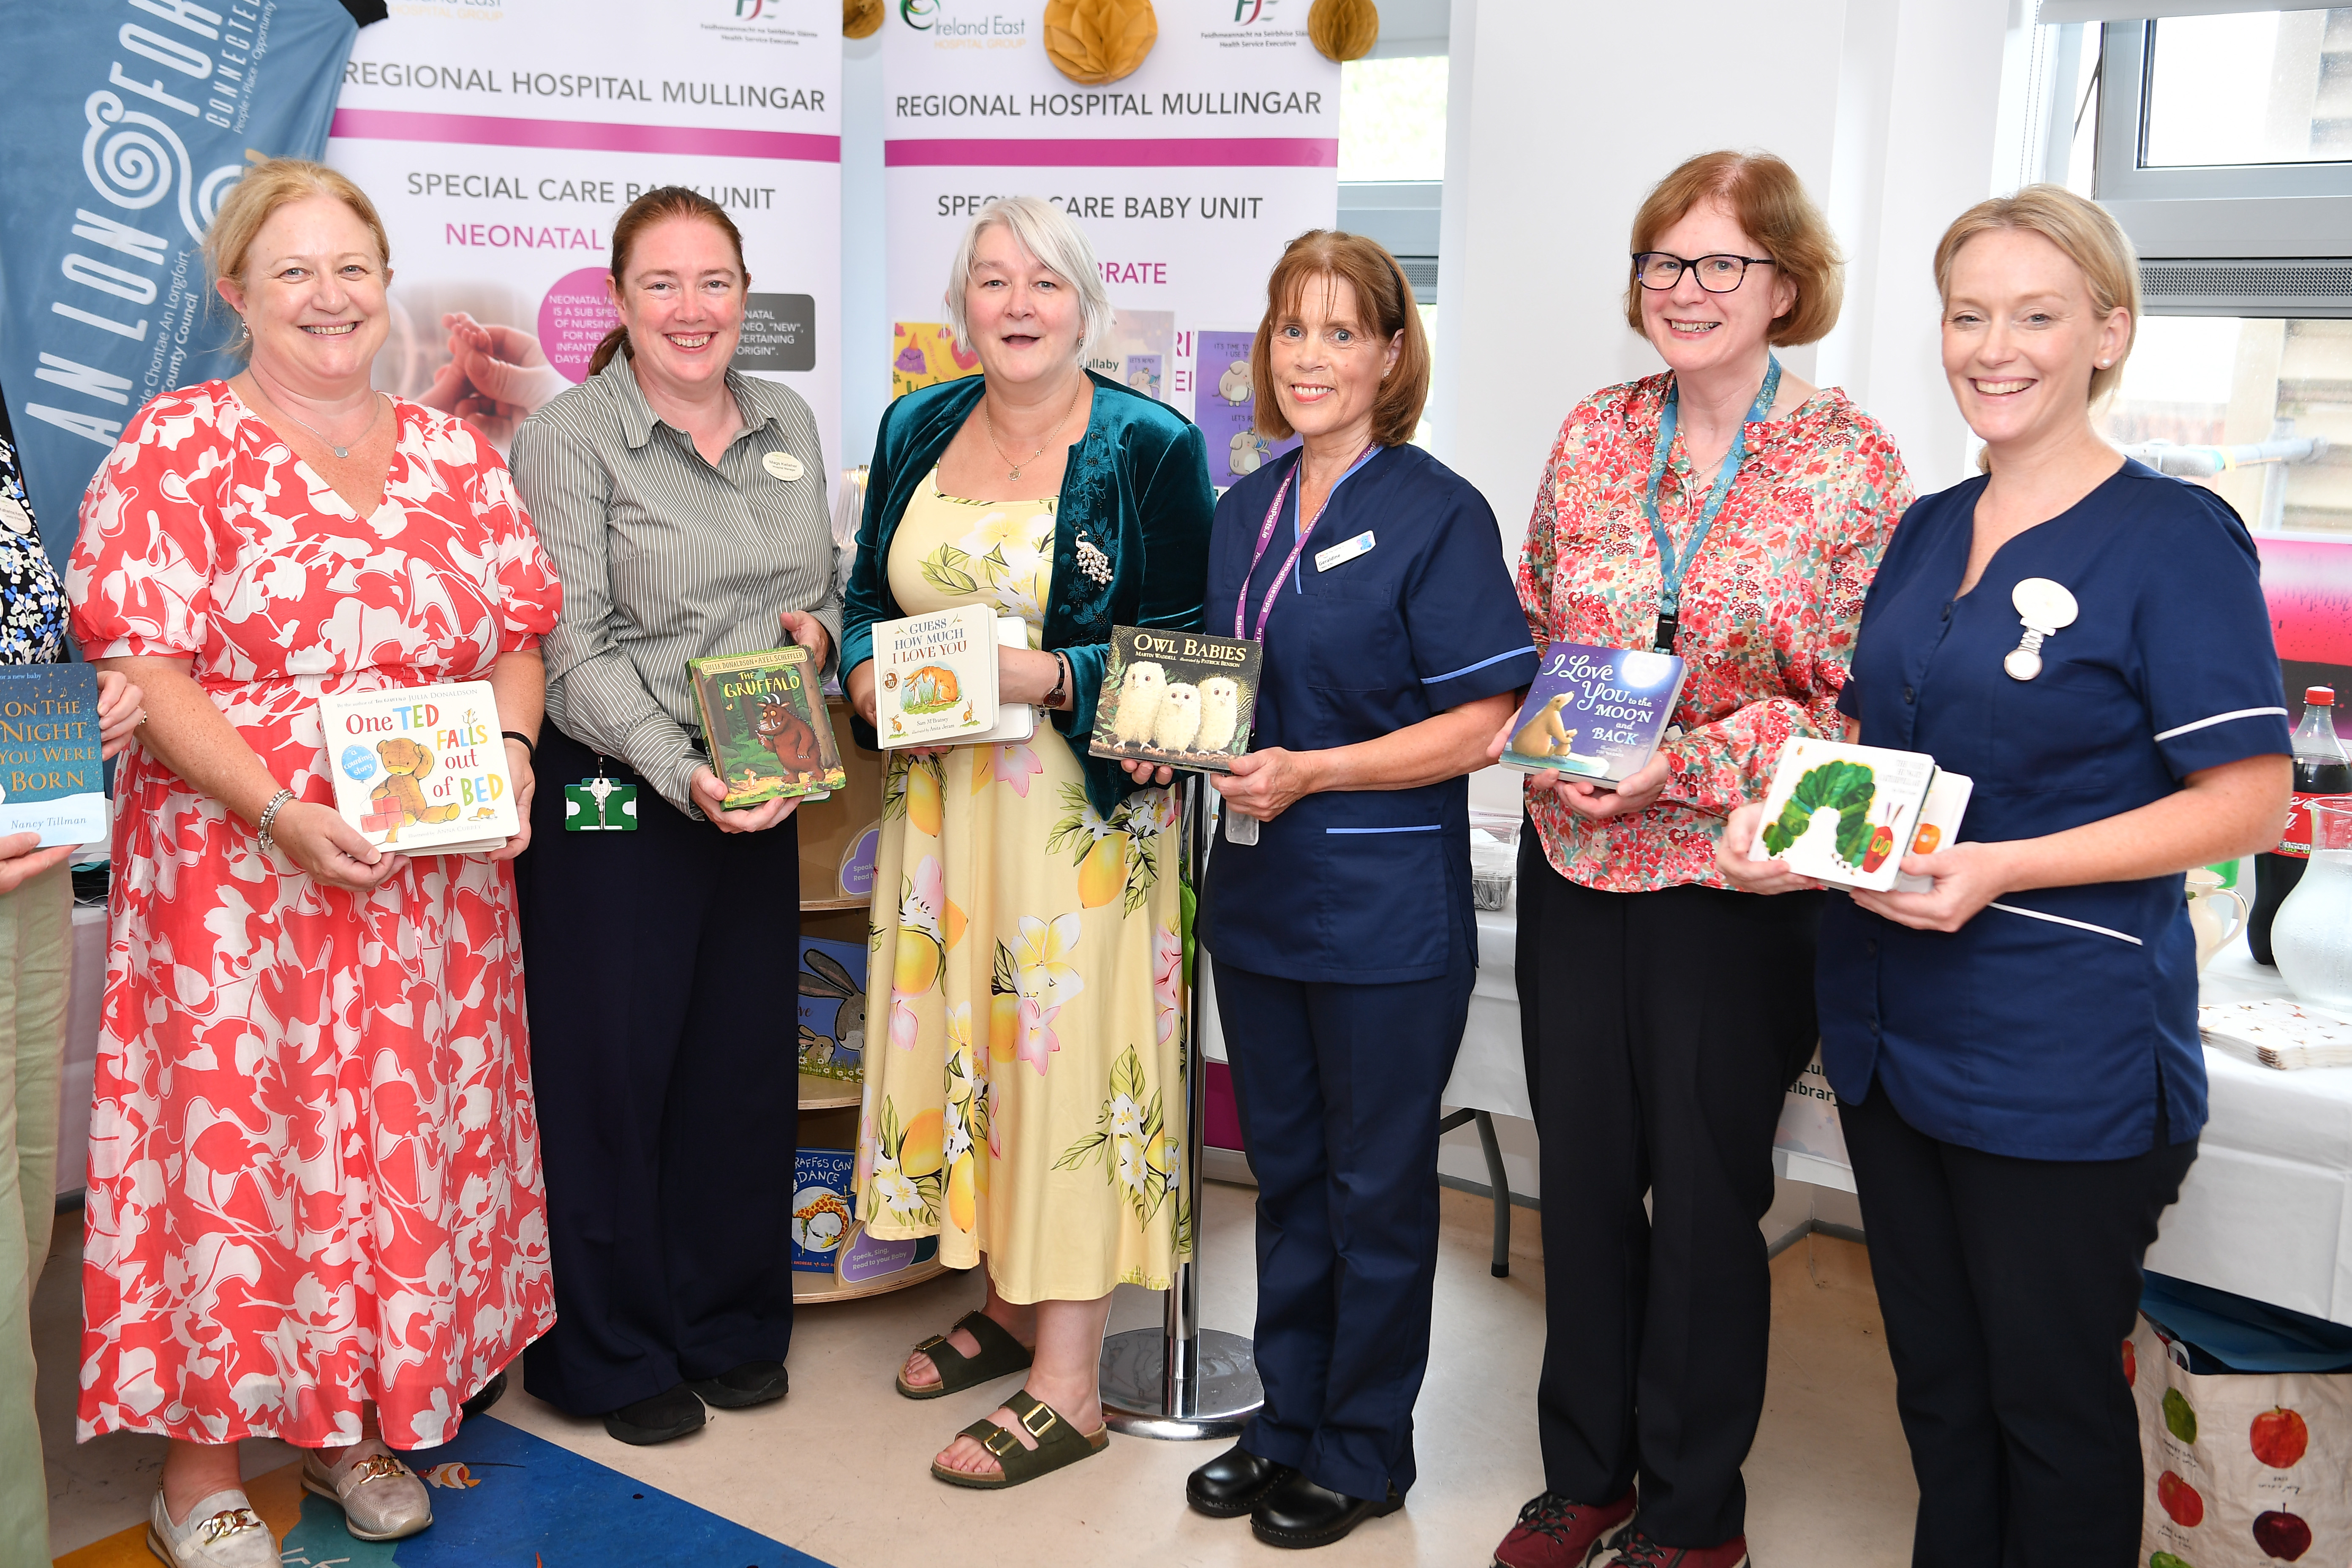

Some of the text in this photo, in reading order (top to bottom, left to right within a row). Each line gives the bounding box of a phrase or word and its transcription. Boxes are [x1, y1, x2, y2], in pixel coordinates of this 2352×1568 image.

[935, 16, 1025, 35] Ireland East
[934, 39, 1026, 49] HOSPITAL GROUP
[205, 0, 261, 129] CONNECTE
[343, 61, 825, 112] REGIONAL HOSPITAL MULLINGAR
[232, 99, 250, 134] People
[242, 66, 258, 94] Place
[896, 91, 1322, 118] REGIONAL HOSPITAL MULLINGAR
[407, 172, 528, 201] SPECIAL
[538, 179, 615, 204] CARE
[711, 186, 776, 210] UNIT
[1124, 197, 1190, 219] BABY
[1200, 197, 1263, 220] UNIT
[445, 223, 604, 251] NEONATAL
[550, 296, 602, 305] NEONATAL
[144, 250, 191, 388] Chontae An Longfoirt
[175, 293, 199, 345] Council
[574, 308, 593, 316] SUB
[555, 320, 569, 328] OF
[740, 335, 795, 344] PERTAINING
[555, 355, 581, 363] DAYS
[1086, 358, 1119, 373] ullaby
[24, 351, 134, 449] AN
[1262, 478, 1290, 539] EducationPosts.ie
[1319, 554, 1340, 566] Geraldine
[909, 618, 947, 634] GUESS
[895, 628, 964, 650] HOW MUCH
[1134, 634, 1247, 662] OWL BABIES
[893, 640, 967, 664] I LOVE YOU
[1154, 653, 1177, 661] WADDELL
[705, 652, 803, 672] JULIA DONALDSON AXEL SCHEFFLER
[1543, 654, 1566, 675] I
[27, 672, 42, 681] baby
[738, 672, 754, 681] THE
[431, 689, 478, 699] DONALDSON
[724, 675, 800, 698] GRUFFALO
[4, 700, 81, 717] ON THE
[1638, 697, 1652, 708] the
[346, 704, 439, 735] One TED
[1594, 704, 1655, 724] MOON
[0, 720, 87, 743] NIGHT
[1616, 721, 1636, 730] and
[437, 725, 488, 751] FALLS
[1592, 727, 1639, 746] BACK
[0, 746, 96, 765] YOU WERE
[344, 753, 374, 770] counting
[445, 748, 479, 769] out
[354, 763, 373, 776] story
[11, 770, 84, 792] BORN
[433, 773, 504, 806] of BED
[11, 817, 87, 830] Nancy Tillman
[853, 873, 869, 881] Read
[795, 1157, 854, 1171] RAFFES CAN'
[796, 1170, 840, 1184] DANCE
[853, 1252, 874, 1261] Speak,
[853, 1262, 868, 1270] Read
[877, 1257, 890, 1266] your
[891, 1252, 907, 1260] Baby
